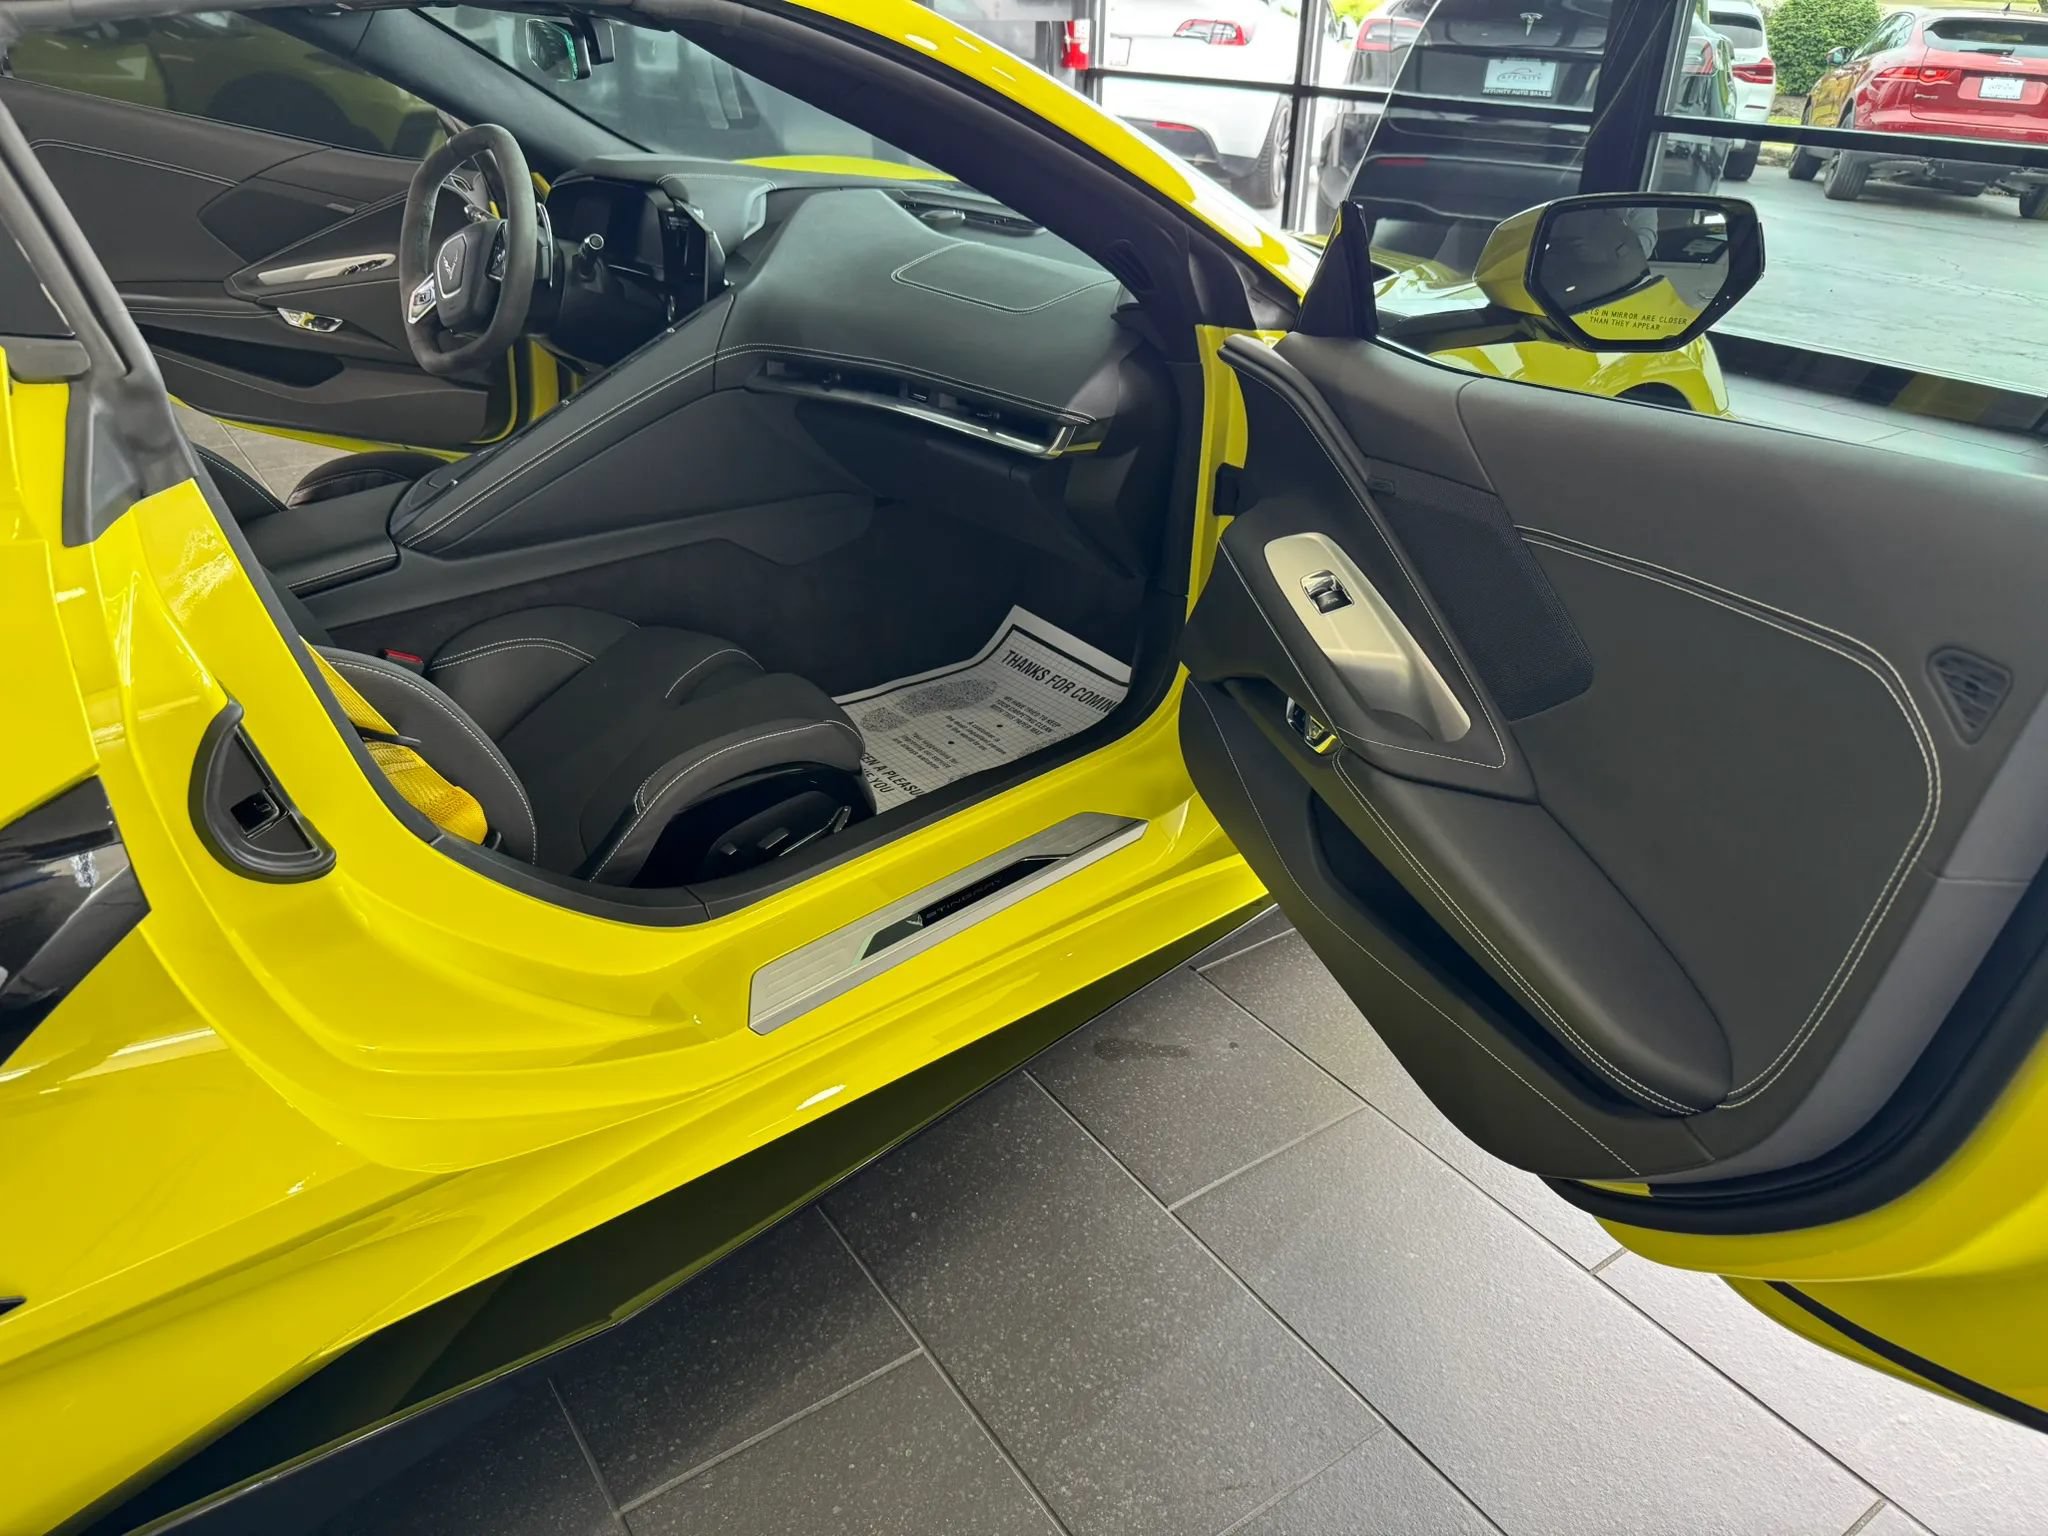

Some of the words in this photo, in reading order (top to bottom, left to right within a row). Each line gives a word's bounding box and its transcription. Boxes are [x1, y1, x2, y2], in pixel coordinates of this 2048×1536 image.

[1590, 316, 1610, 324] THAN
[1611, 319, 1631, 328] THEY
[1632, 322, 1661, 331] APPEAR
[1611, 311, 1638, 320] MIRROR
[1641, 314, 1656, 322] ARE
[1659, 316, 1688, 325] CLOSER
[1001, 649, 1051, 681] THANKS
[1045, 674, 1076, 695] FOR
[869, 778, 895, 793] YOU
[926, 880, 1001, 919] STINGRAY
